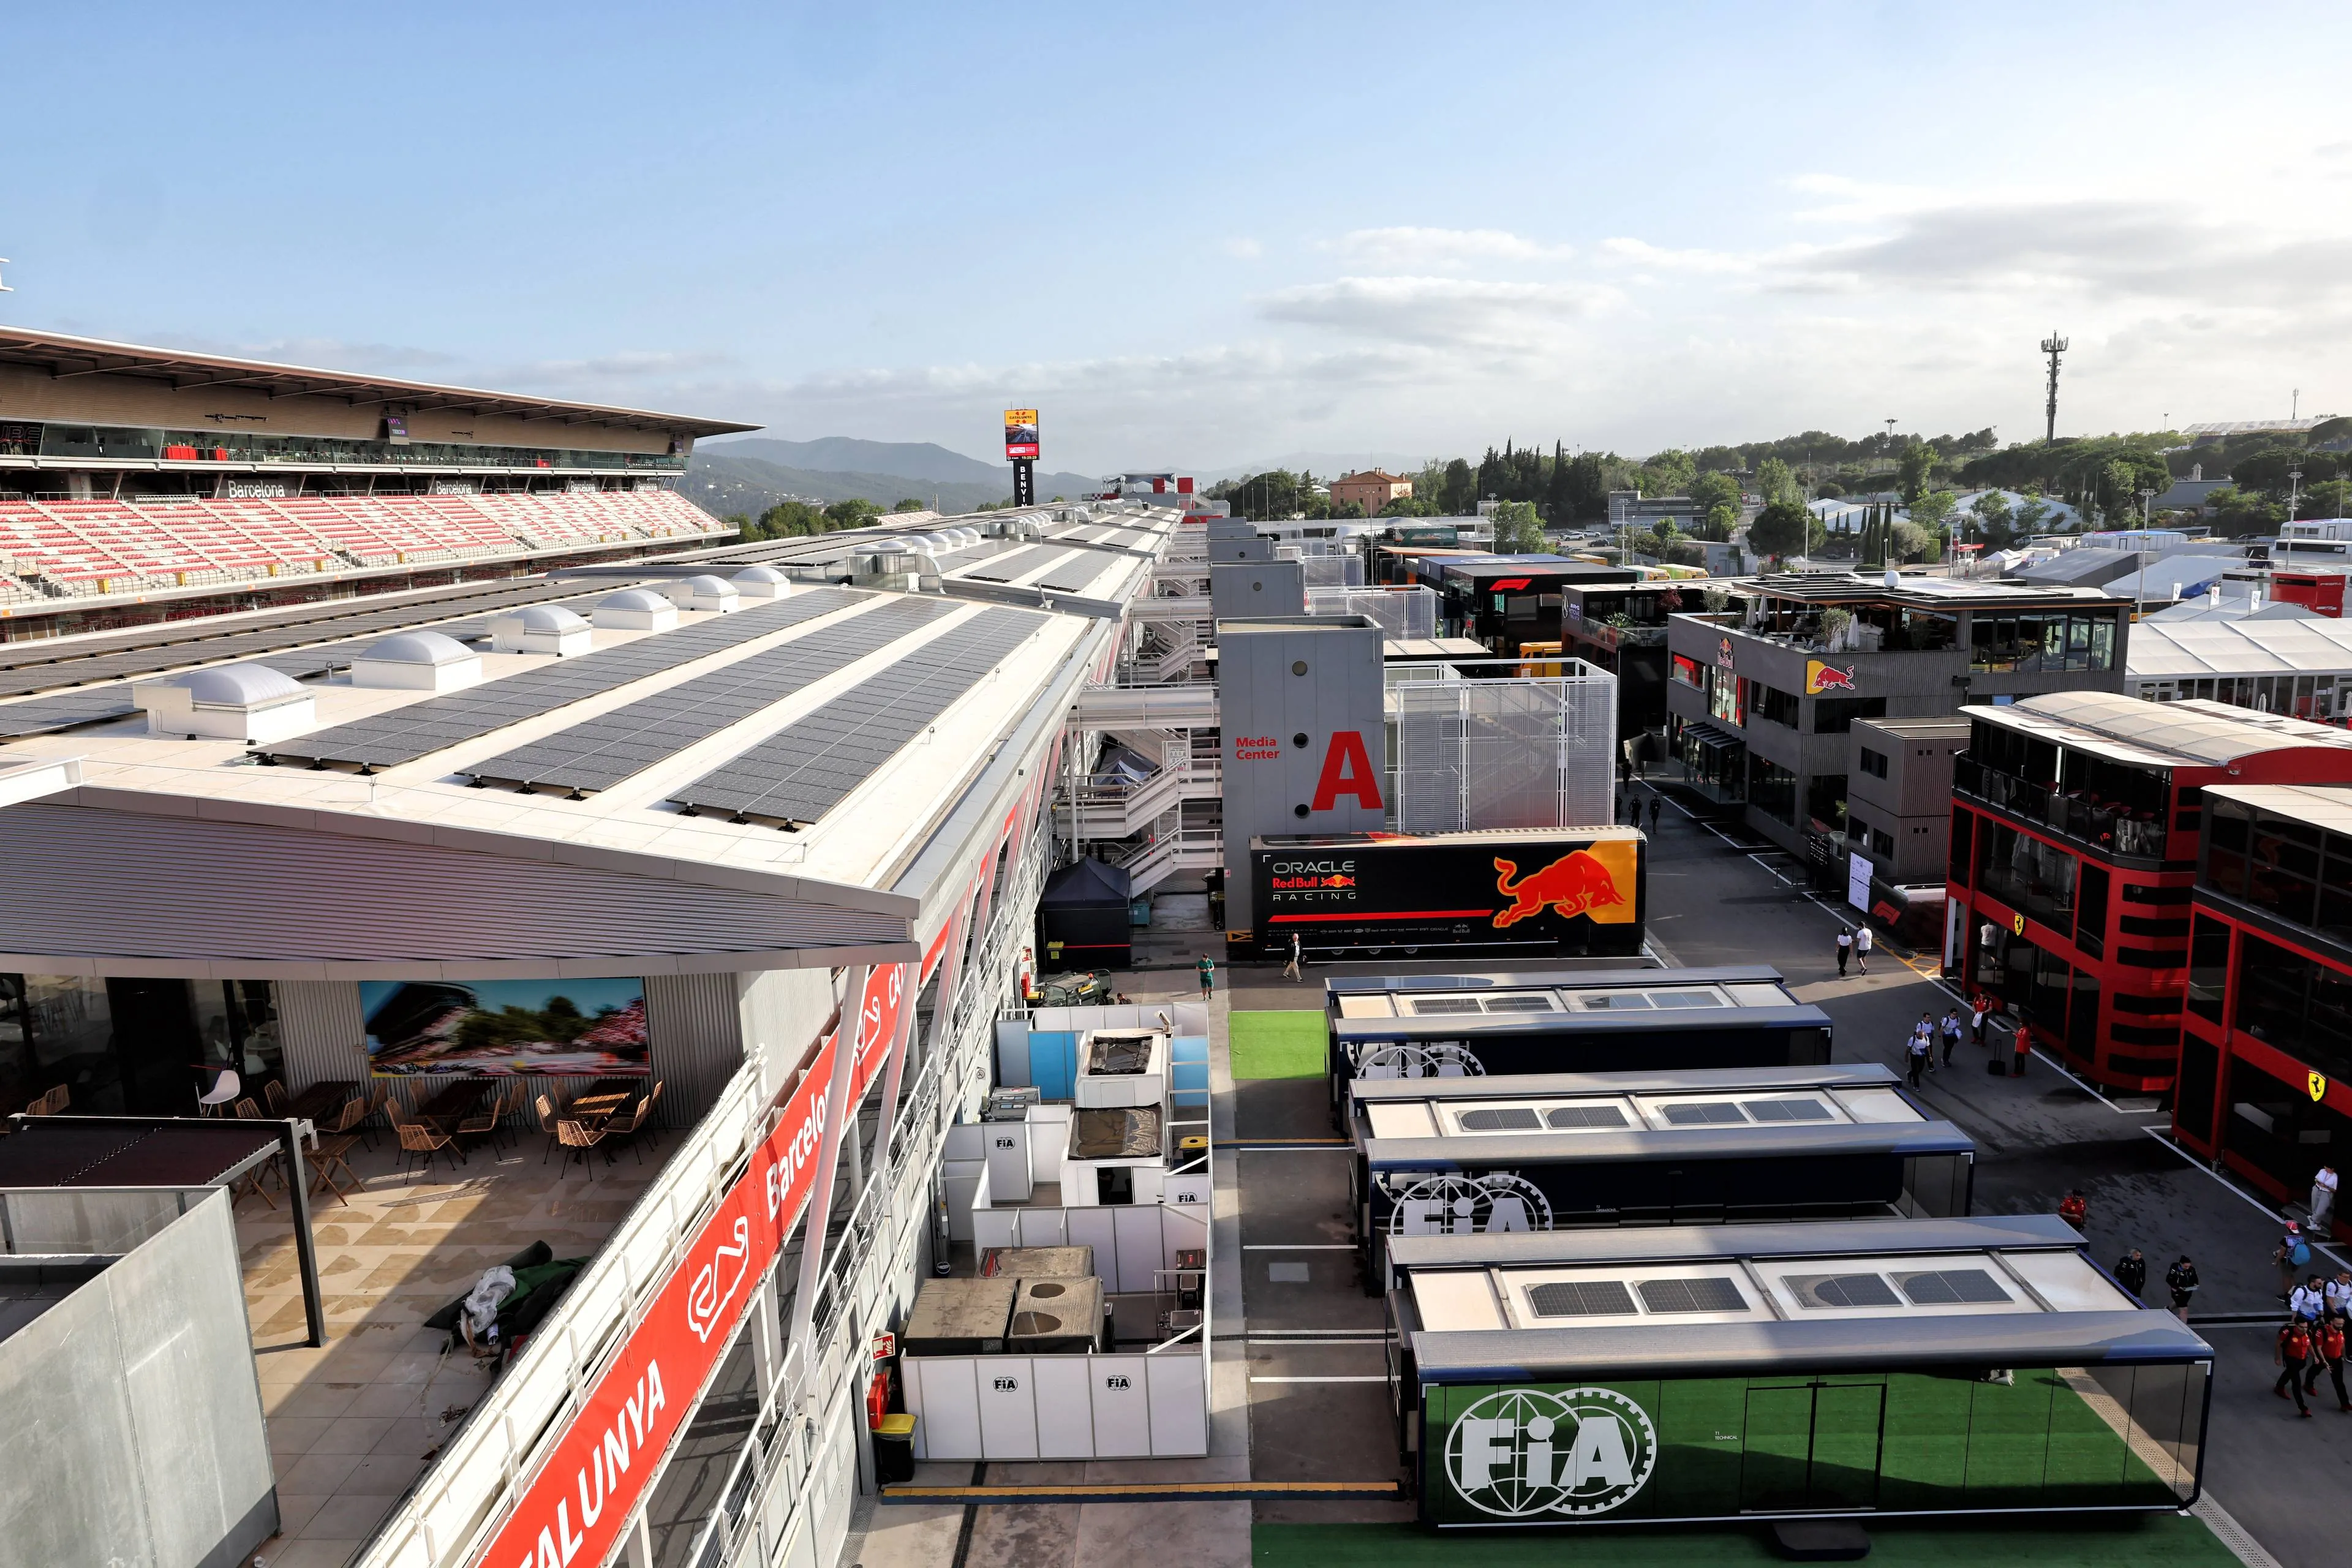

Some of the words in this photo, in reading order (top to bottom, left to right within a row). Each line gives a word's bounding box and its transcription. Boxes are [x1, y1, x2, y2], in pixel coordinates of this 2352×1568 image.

[228, 480, 285, 498] Barcelona
[436, 481, 472, 495] Barcelona
[570, 481, 595, 492] Barcelona
[637, 481, 657, 491] Barcelona
[1489, 579, 1532, 591] F1
[1717, 652, 1725, 666] Red
[1725, 655, 1734, 669] Bull
[1235, 737, 1277, 747] Media
[1236, 749, 1280, 760] Center
[1310, 731, 1384, 811] A
[1272, 861, 1355, 874] ORACLE
[1272, 877, 1295, 888] Red
[1296, 876, 1318, 888] Bull
[1273, 892, 1356, 901] RACING
[1872, 900, 1901, 926] F1
